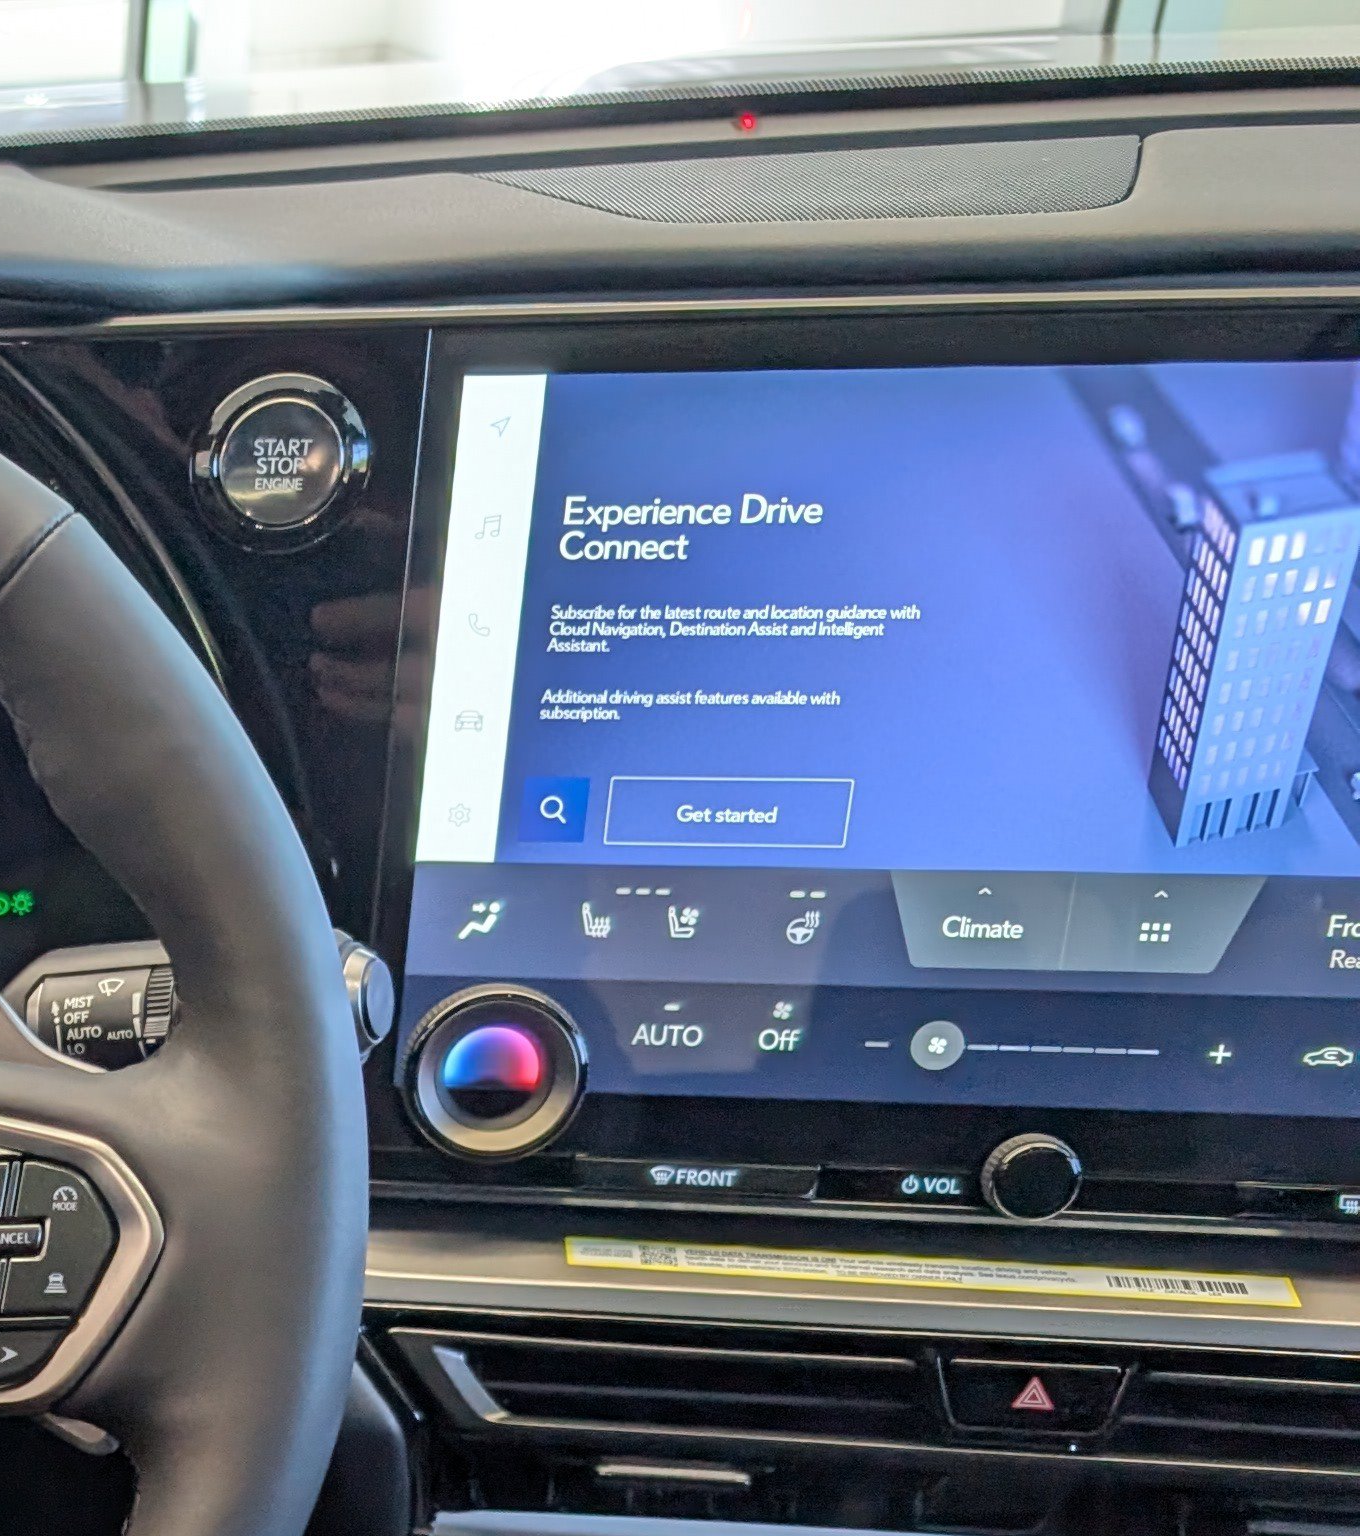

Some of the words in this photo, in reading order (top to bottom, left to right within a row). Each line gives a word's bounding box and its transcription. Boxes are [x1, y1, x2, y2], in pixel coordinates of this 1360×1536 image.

[253, 438, 314, 457] START
[256, 457, 305, 475] STOP
[254, 477, 304, 491] ENGINE
[562, 496, 731, 532] Experience
[740, 493, 823, 524] Drive
[559, 531, 689, 560] Connect
[550, 604, 615, 620] Subscribe
[617, 604, 638, 620] for
[640, 604, 662, 620] the
[664, 604, 701, 620] latest
[703, 606, 741, 620] route
[743, 604, 770, 620] and
[771, 604, 823, 620] location
[825, 604, 887, 623] guidance
[890, 604, 921, 620] with
[549, 621, 590, 636] Cloud
[592, 621, 666, 639] Navigation,
[669, 621, 746, 637] Destination
[747, 621, 788, 636] Assist
[790, 621, 817, 636] and
[818, 621, 884, 639] Intelligent
[546, 637, 611, 653] Assistant.
[540, 688, 608, 704] Additional
[609, 689, 654, 708] driving
[656, 690, 692, 705] assist
[694, 689, 749, 705] features
[751, 690, 807, 705] available
[810, 690, 841, 705] with
[539, 705, 621, 722] subscription.
[676, 804, 712, 823] Get
[715, 806, 779, 824] started
[942, 915, 1024, 939] Climate
[64, 995, 94, 1010] MIST
[64, 1010, 90, 1025] OFF
[66, 1026, 102, 1041] AUTO
[106, 1029, 133, 1041] AUTO
[631, 1024, 704, 1048] AUTO
[758, 1028, 803, 1052] Off
[676, 1168, 739, 1188] FRONT
[924, 1176, 961, 1195] VOL
[52, 1201, 78, 1212] MODE
